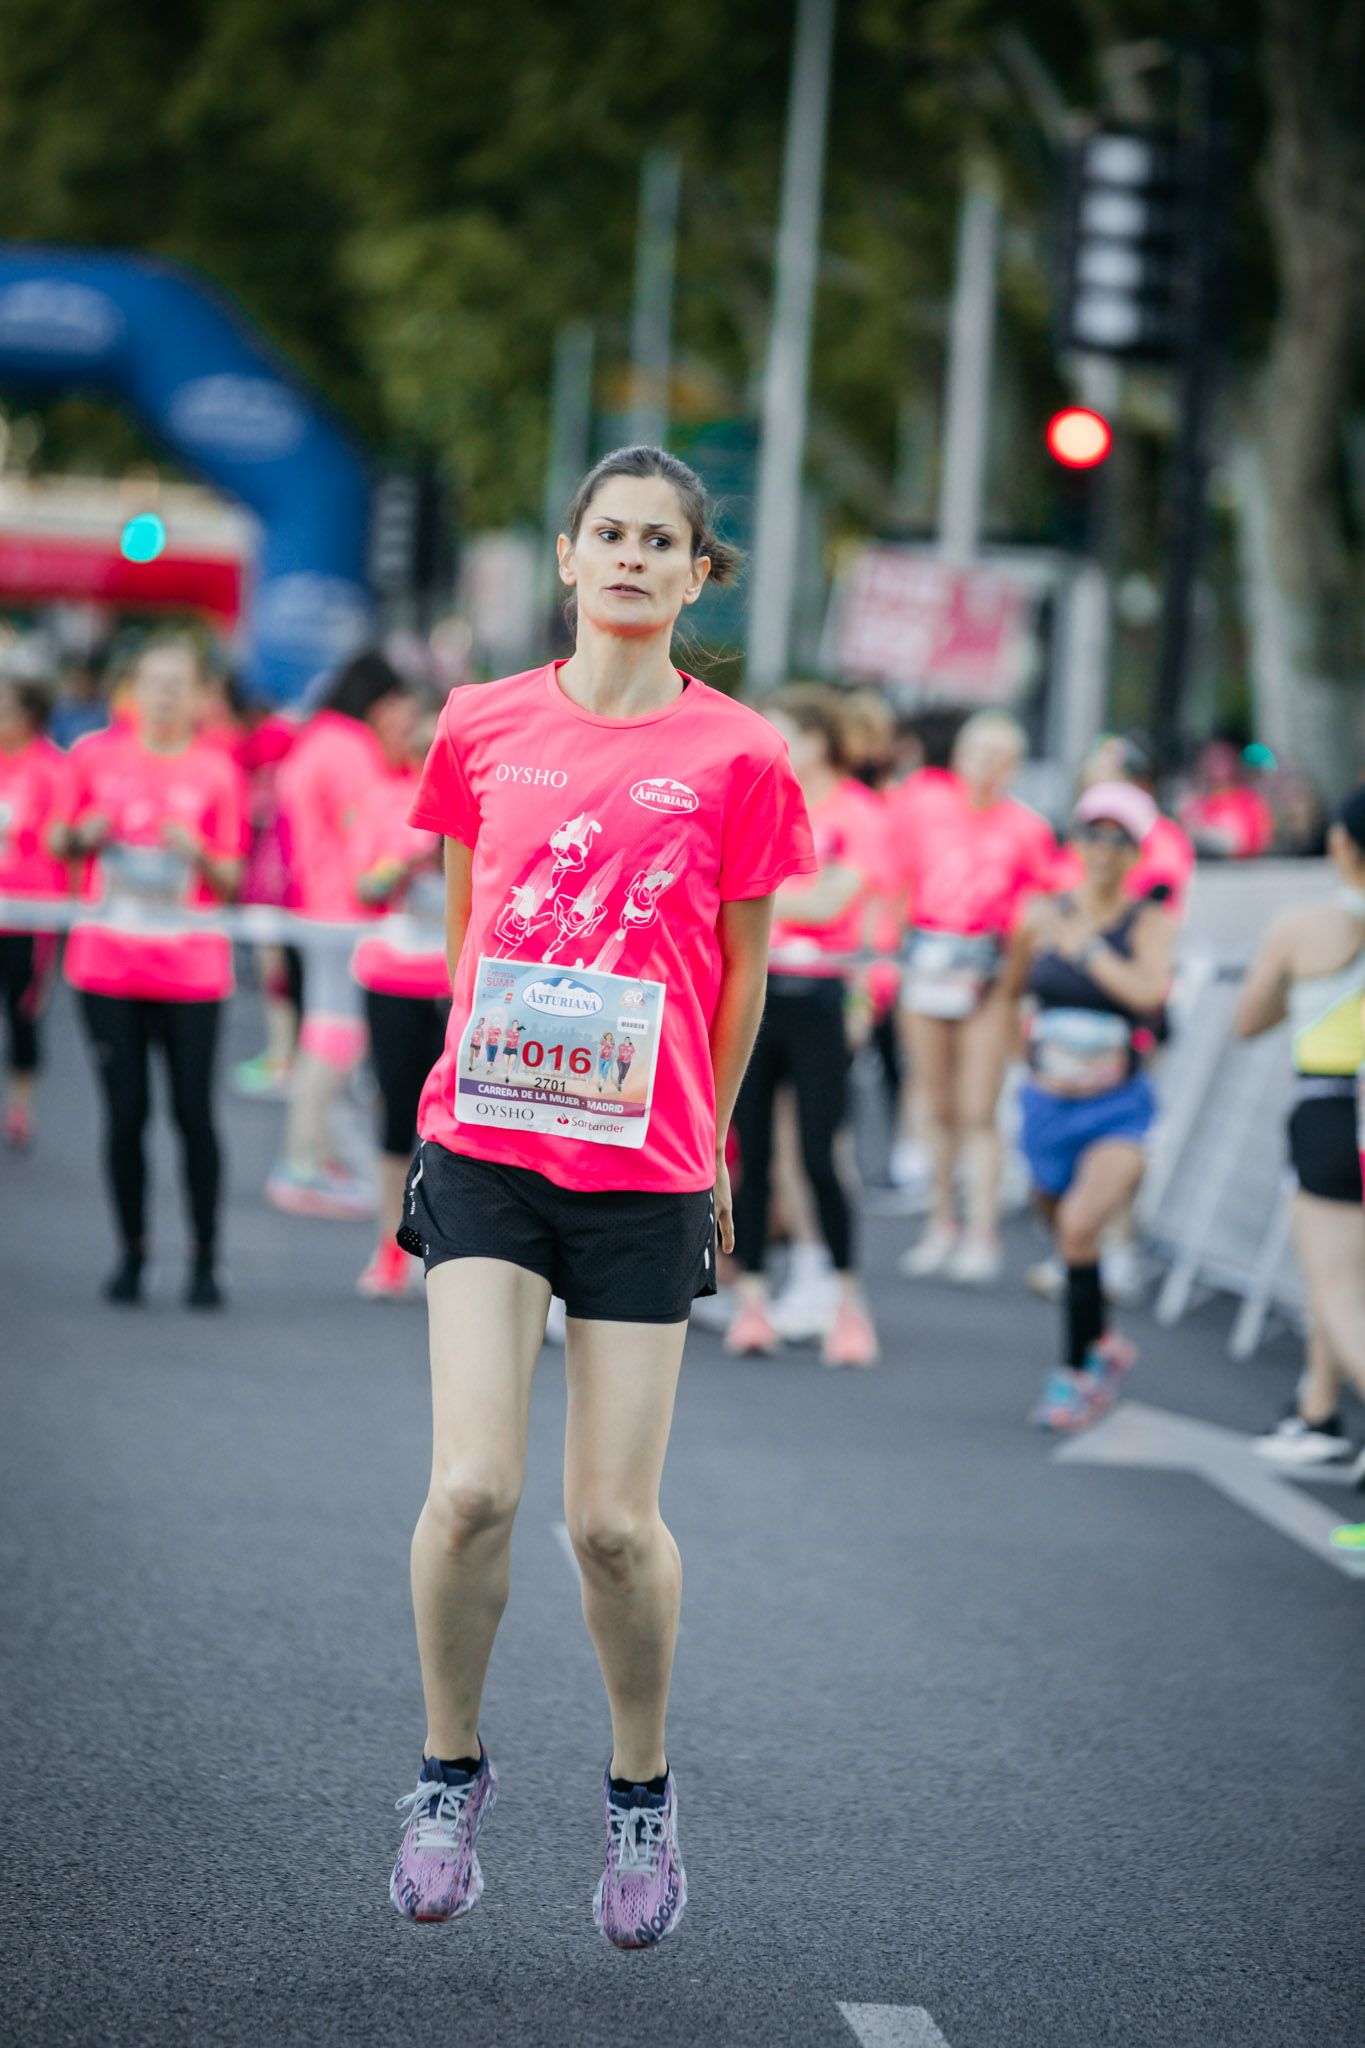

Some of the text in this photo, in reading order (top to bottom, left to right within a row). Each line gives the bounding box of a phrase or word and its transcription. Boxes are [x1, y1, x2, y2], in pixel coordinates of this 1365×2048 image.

[496, 764, 568, 788] OYSHO
[635, 786, 693, 810] ASTURIANA
[527, 988, 597, 1011] ASTURIANA
[522, 1040, 591, 1074] 016
[534, 1077, 566, 1092] 2701
[478, 1084, 624, 1114] CARRERA DE LA MUJER MADRID
[476, 1103, 534, 1121] OYSHO
